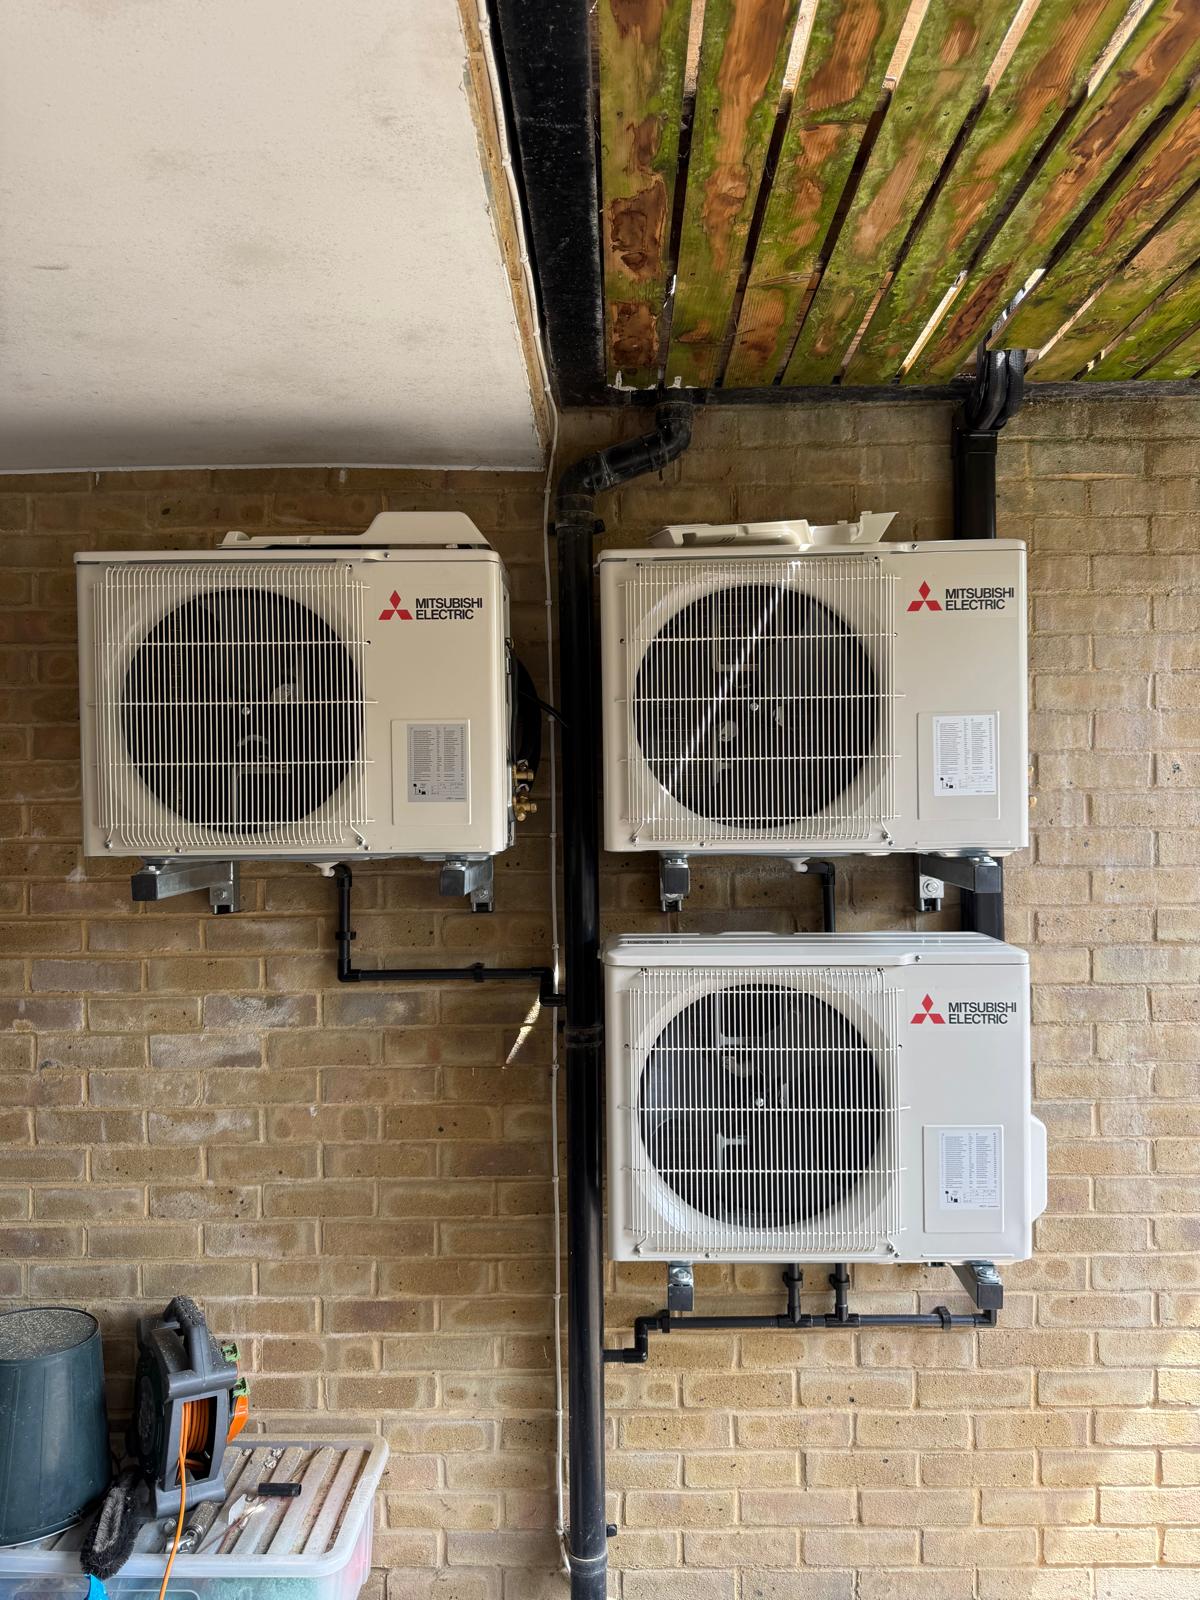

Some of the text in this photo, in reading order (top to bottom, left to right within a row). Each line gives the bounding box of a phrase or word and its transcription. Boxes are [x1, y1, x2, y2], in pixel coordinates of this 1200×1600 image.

[945, 587, 1014, 599] MITSUBISHI
[415, 598, 482, 608] MITSUBISHI
[945, 599, 1005, 610] ELECTRIC
[415, 608, 473, 620] ELECTRIC
[948, 1002, 1016, 1012] MITSUBISHI
[948, 1013, 1007, 1024] ELECTRIC
